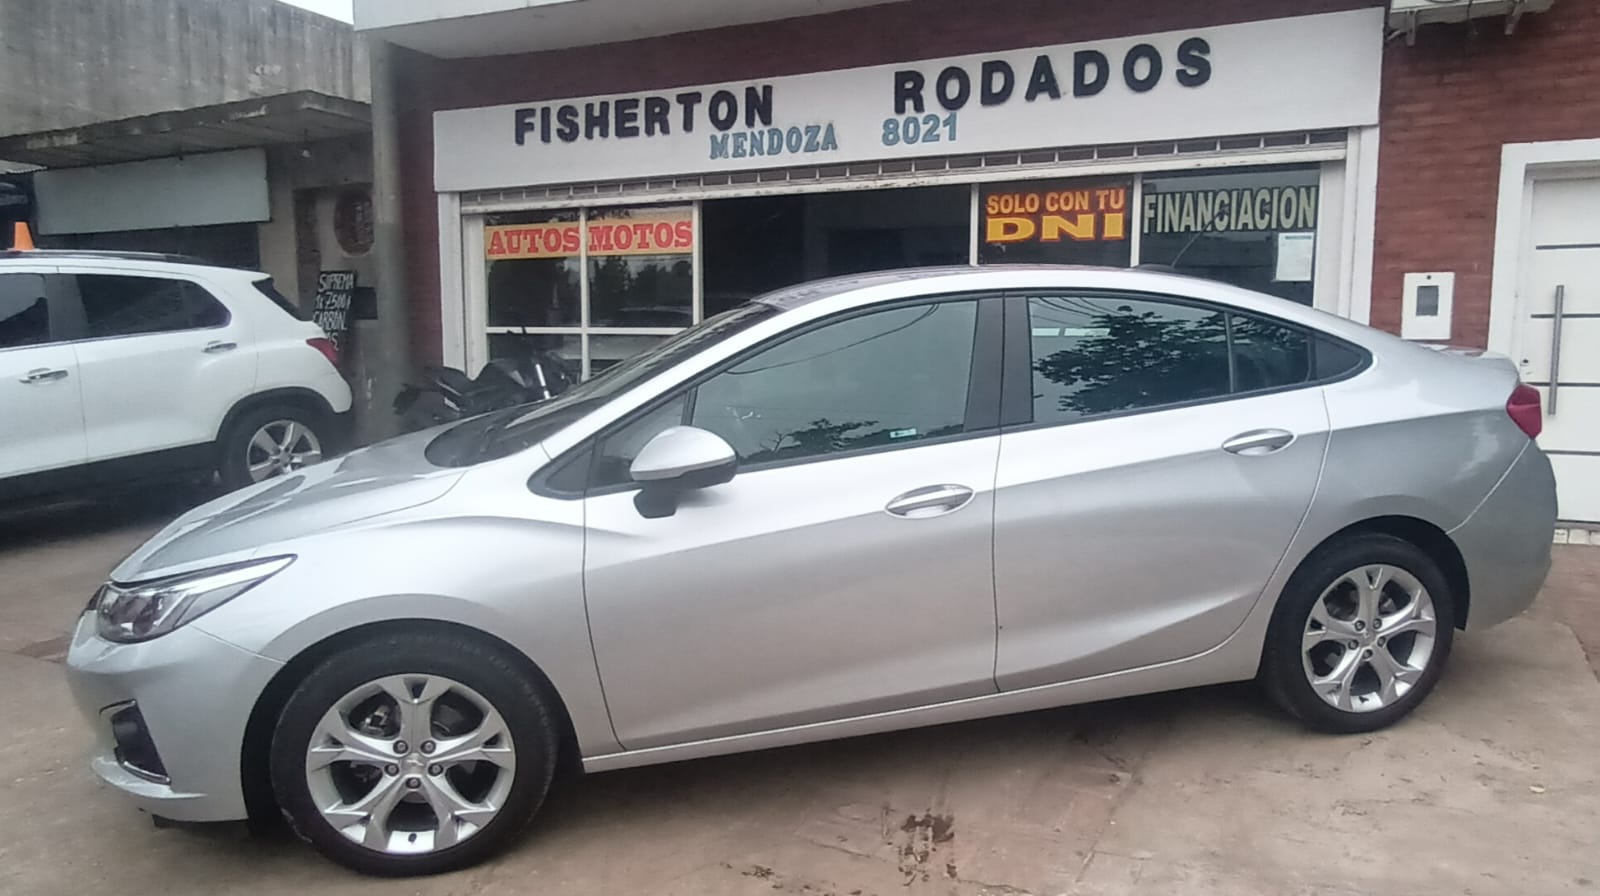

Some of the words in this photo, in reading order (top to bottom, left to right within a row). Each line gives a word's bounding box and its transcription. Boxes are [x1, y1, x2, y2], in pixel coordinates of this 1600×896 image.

[515, 85, 773, 146] FISHERTON
[893, 37, 1211, 114] RODADOS
[710, 123, 838, 160] MENDOZA
[882, 112, 957, 145] 8021
[986, 194, 1038, 215] SOLO
[1045, 191, 1092, 213] CON
[1096, 188, 1125, 210] TU
[1144, 187, 1316, 233] FINANCIACION
[487, 228, 580, 255] AUTOS
[588, 222, 692, 252] MOTOS
[985, 213, 1126, 243] DNI
